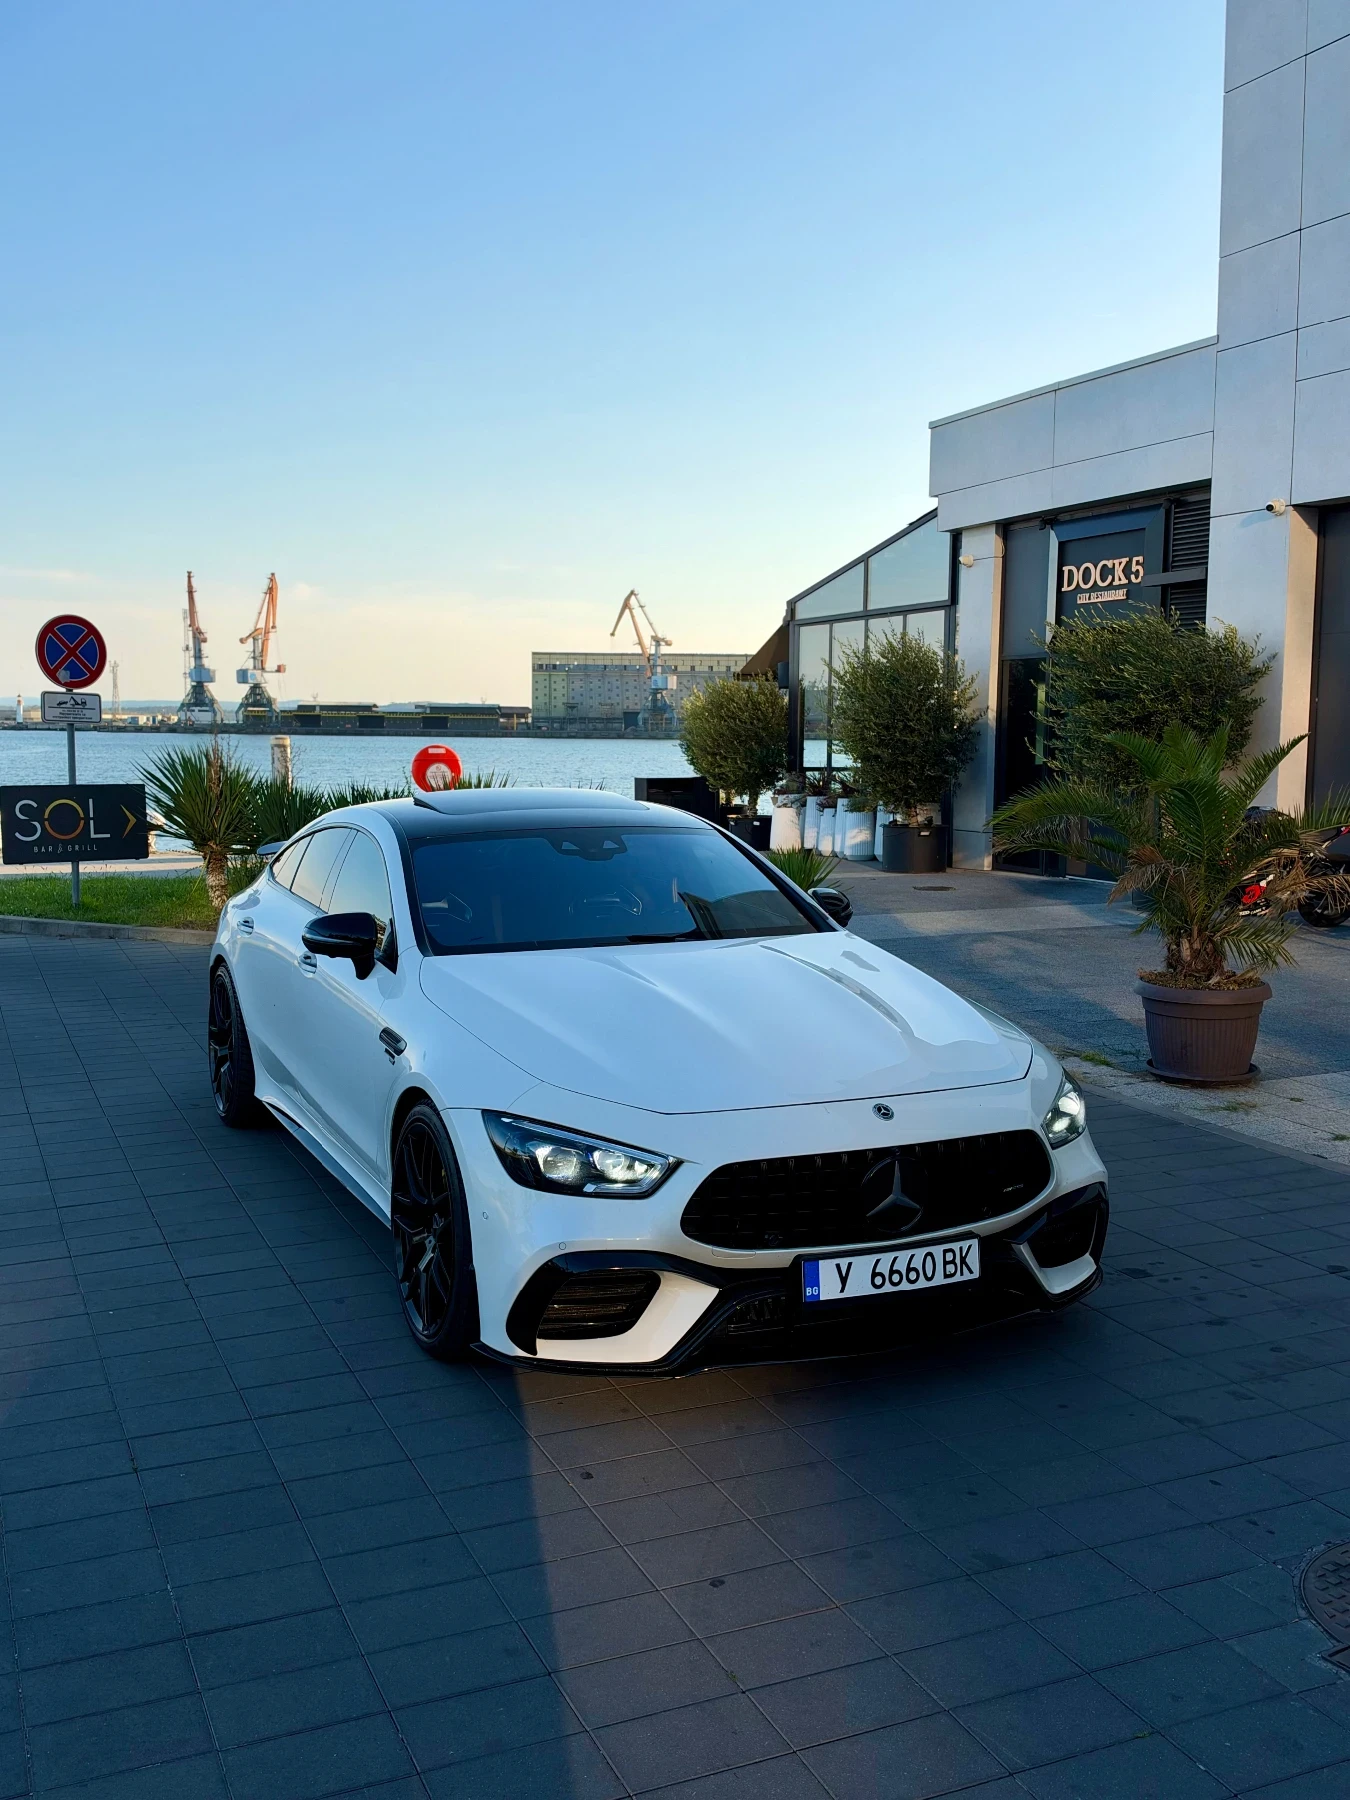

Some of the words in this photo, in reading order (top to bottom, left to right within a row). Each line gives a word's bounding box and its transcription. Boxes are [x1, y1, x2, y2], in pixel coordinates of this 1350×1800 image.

[1077, 593, 1089, 604] CITY
[1090, 589, 1128, 602] RESTAURANT
[15, 798, 111, 842] SOL
[33, 845, 53, 853] BAR
[57, 844, 63, 854] &
[67, 844, 98, 852] GRILL
[870, 1251, 937, 1290] 6660
[942, 1244, 974, 1280] BK
[806, 1286, 819, 1296] BG
